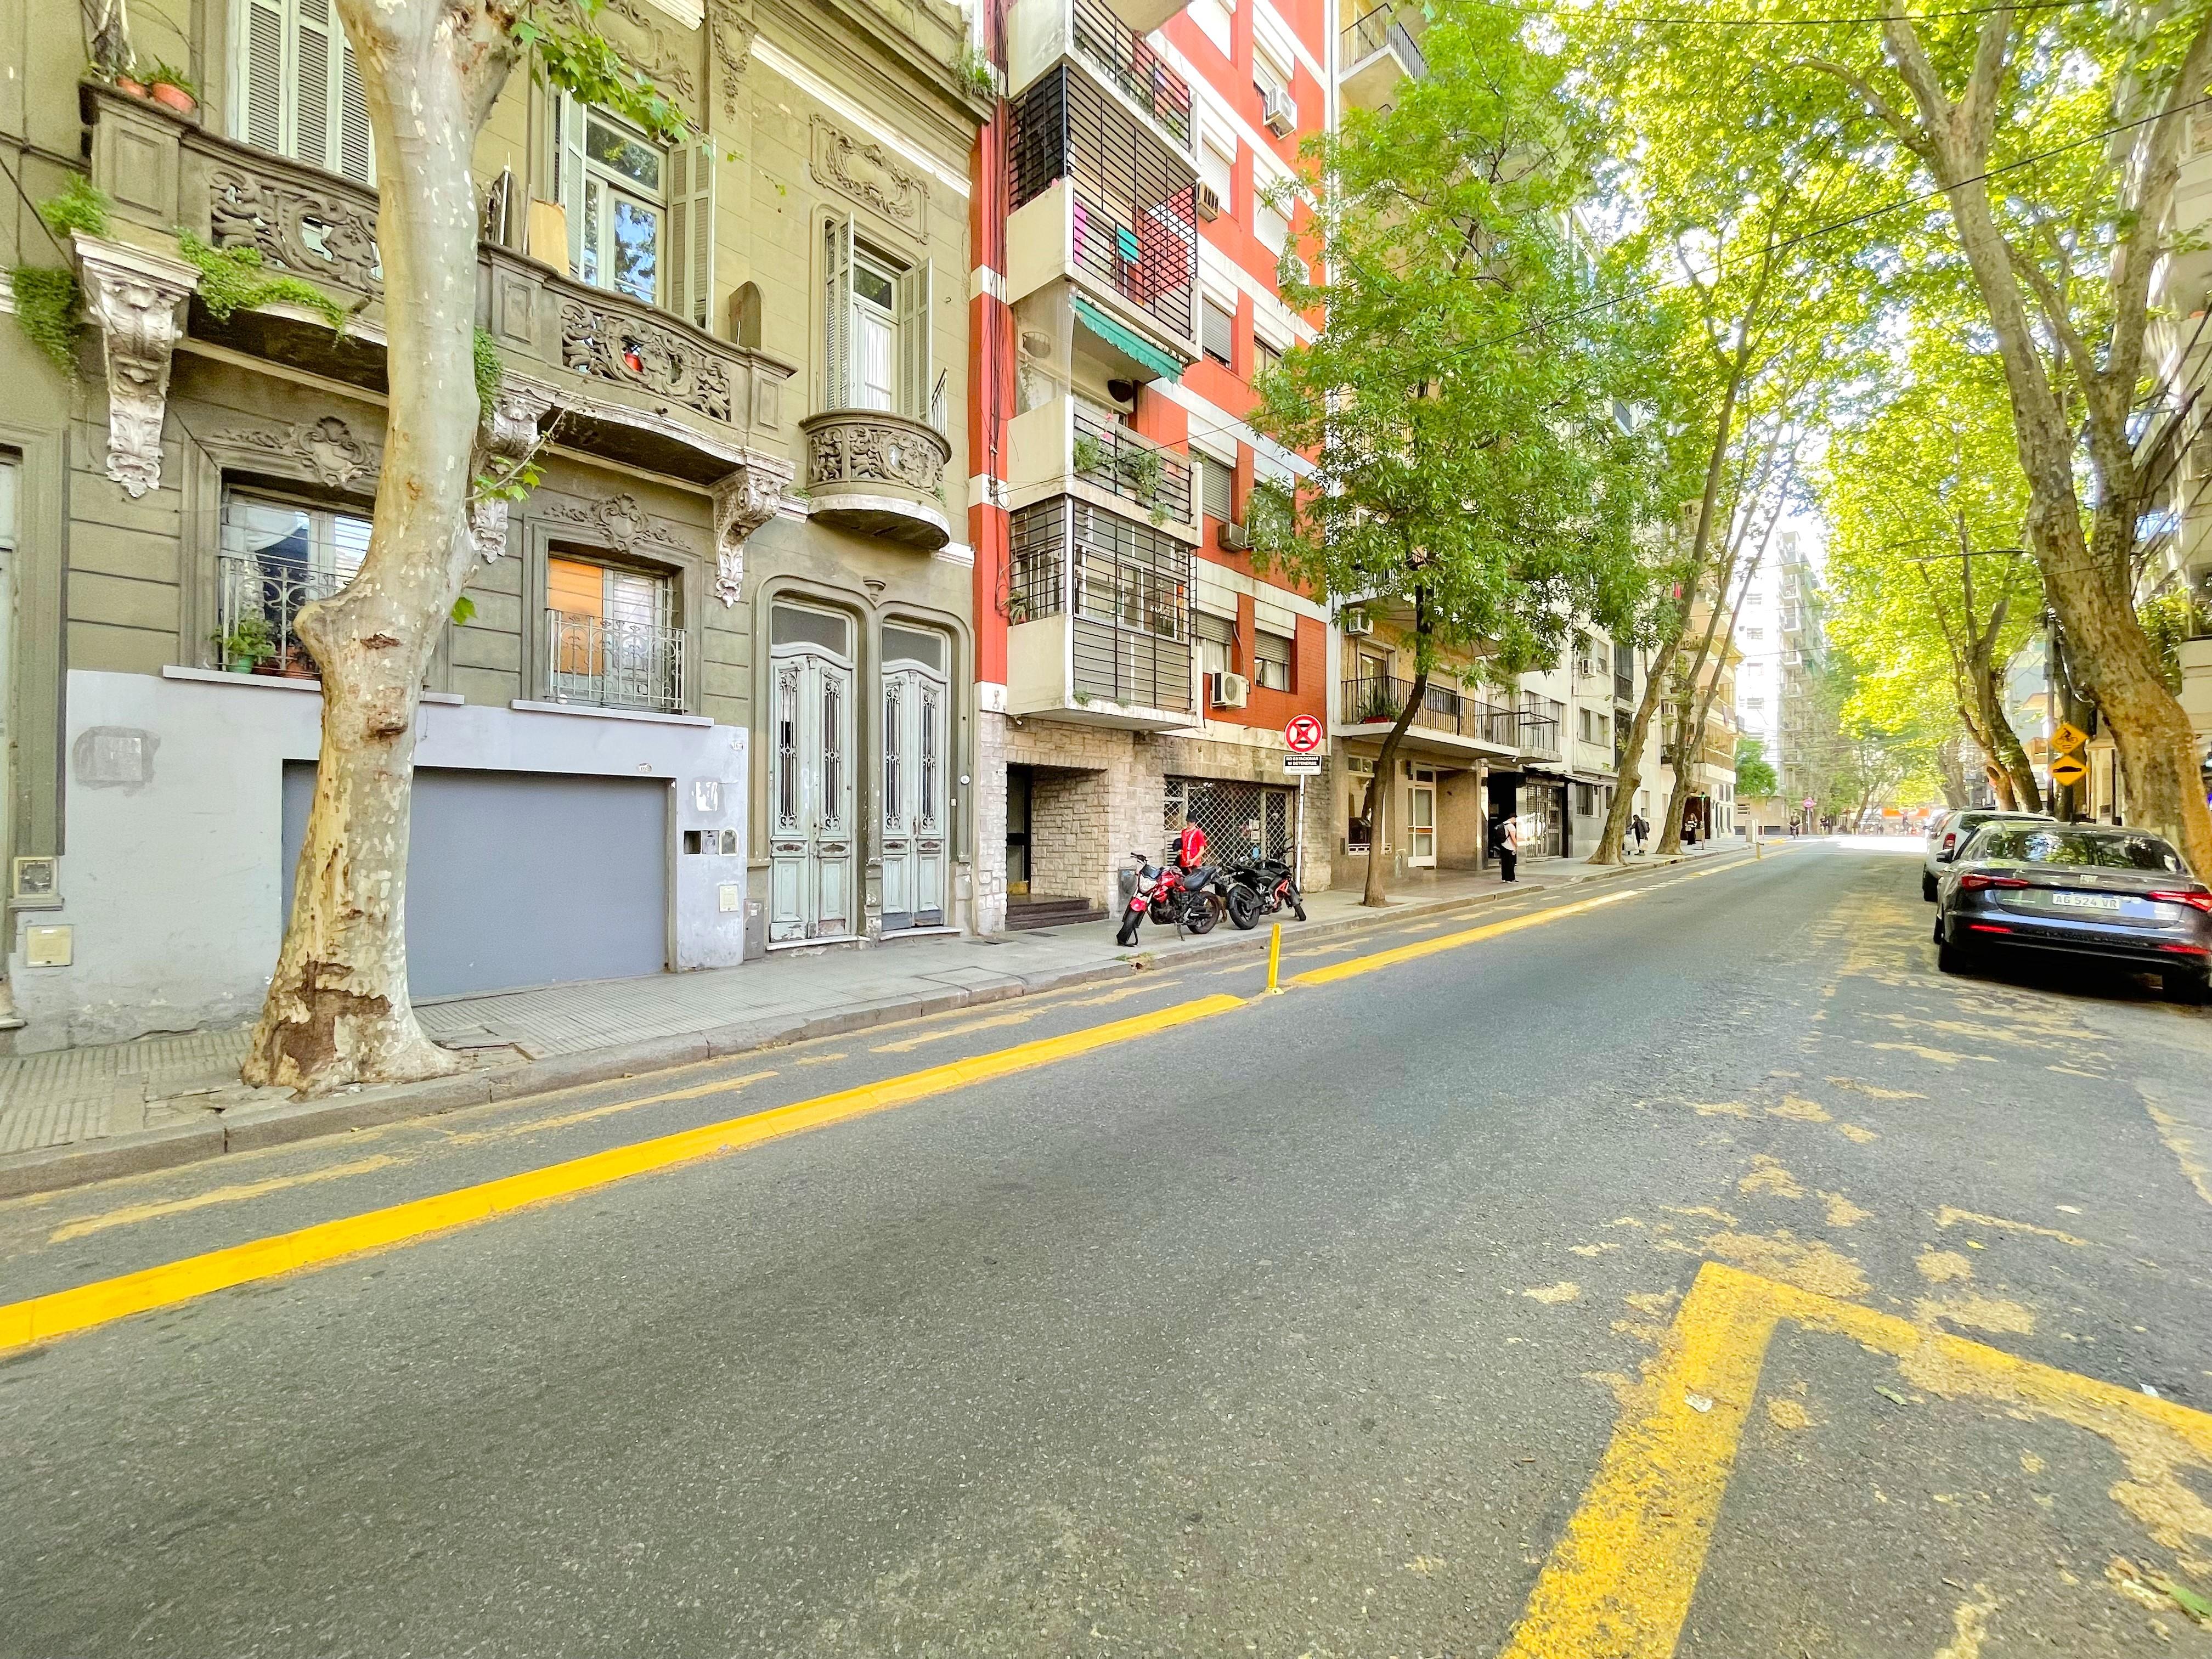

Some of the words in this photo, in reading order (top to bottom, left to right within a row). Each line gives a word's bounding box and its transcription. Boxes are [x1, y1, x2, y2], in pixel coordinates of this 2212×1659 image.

[2056, 895, 2070, 904] AG
[2074, 897, 2097, 906] 524
[2102, 899, 2117, 907] VR
